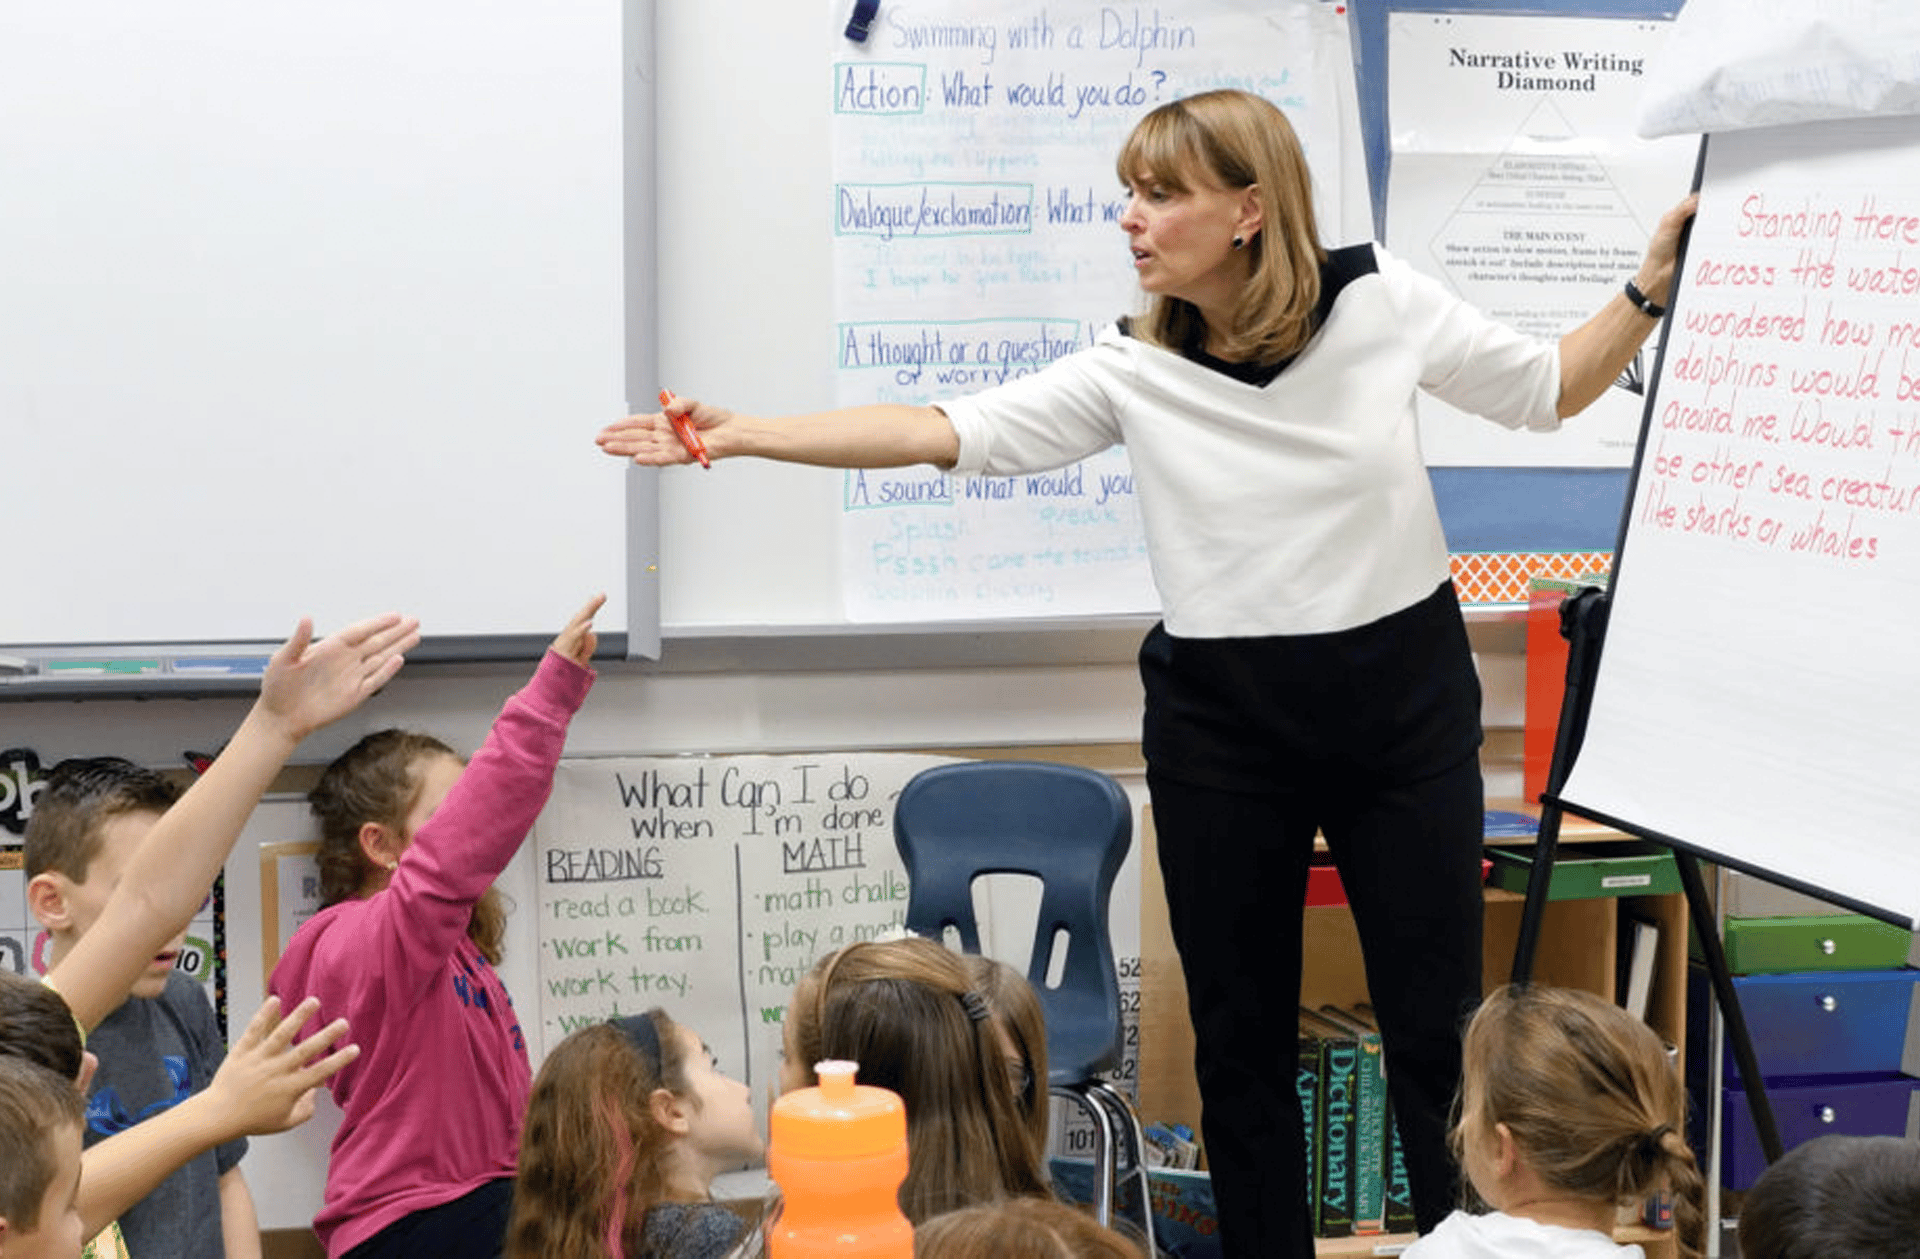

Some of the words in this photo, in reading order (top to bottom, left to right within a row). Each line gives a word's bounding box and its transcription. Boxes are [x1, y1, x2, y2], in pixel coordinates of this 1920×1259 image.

[889, 10, 996, 64] Swimming
[1008, 20, 1054, 50] with
[1066, 32, 1083, 50] a
[1100, 10, 1196, 68] Dolphin
[1449, 48, 1556, 70] Narrative
[1563, 52, 1645, 75] Writing
[1497, 71, 1596, 92] Diamond
[941, 76, 993, 106] What
[1006, 73, 1065, 106] would
[1068, 82, 1115, 118] you
[1048, 188, 1093, 224] What
[1503, 231, 1521, 241] THE
[1525, 231, 1551, 241] MAIN
[1553, 232, 1586, 242] EVENT
[1738, 192, 1842, 262] Standing
[1854, 193, 1920, 244] there
[1696, 259, 1776, 287] across
[1791, 248, 1836, 290] the
[1848, 248, 1920, 295] wate
[1685, 296, 1807, 342] wondered
[1820, 300, 1874, 347] how
[845, 327, 860, 366] A
[868, 329, 943, 378] thought
[949, 341, 970, 364] or
[977, 341, 989, 364] a
[1674, 341, 1779, 405] dolphins
[1791, 348, 1884, 399] would
[896, 367, 921, 385] or
[1663, 388, 1737, 434] around
[1790, 399, 1875, 449] Would
[852, 468, 871, 505] A
[966, 474, 1015, 500] What
[1026, 463, 1086, 498] would
[1096, 474, 1134, 505] you
[1654, 435, 1683, 478] be
[1691, 445, 1764, 490] other
[1769, 464, 1813, 501] sea
[1641, 480, 1677, 529] like
[1683, 491, 1752, 538] sharks
[1757, 517, 1784, 547] or
[1790, 508, 1878, 559] whales
[616, 766, 709, 808] What
[720, 766, 781, 808] Can
[792, 765, 820, 804] I
[829, 765, 869, 801] do
[742, 803, 801, 836] I'm
[823, 804, 885, 831] done
[547, 846, 664, 883] READING
[783, 833, 867, 874] MATH
[552, 892, 610, 920] read
[618, 897, 635, 916] a
[765, 877, 832, 912] math
[175, 949, 200, 973] 10
[552, 930, 628, 960] work
[641, 925, 702, 953] from
[763, 921, 818, 962] play
[830, 925, 845, 944] a
[548, 968, 620, 998] work
[1119, 957, 1141, 978] 52
[1124, 1024, 1139, 1046] 2
[1068, 1129, 1095, 1150] 101
[1322, 1048, 1357, 1212] Dictionary
